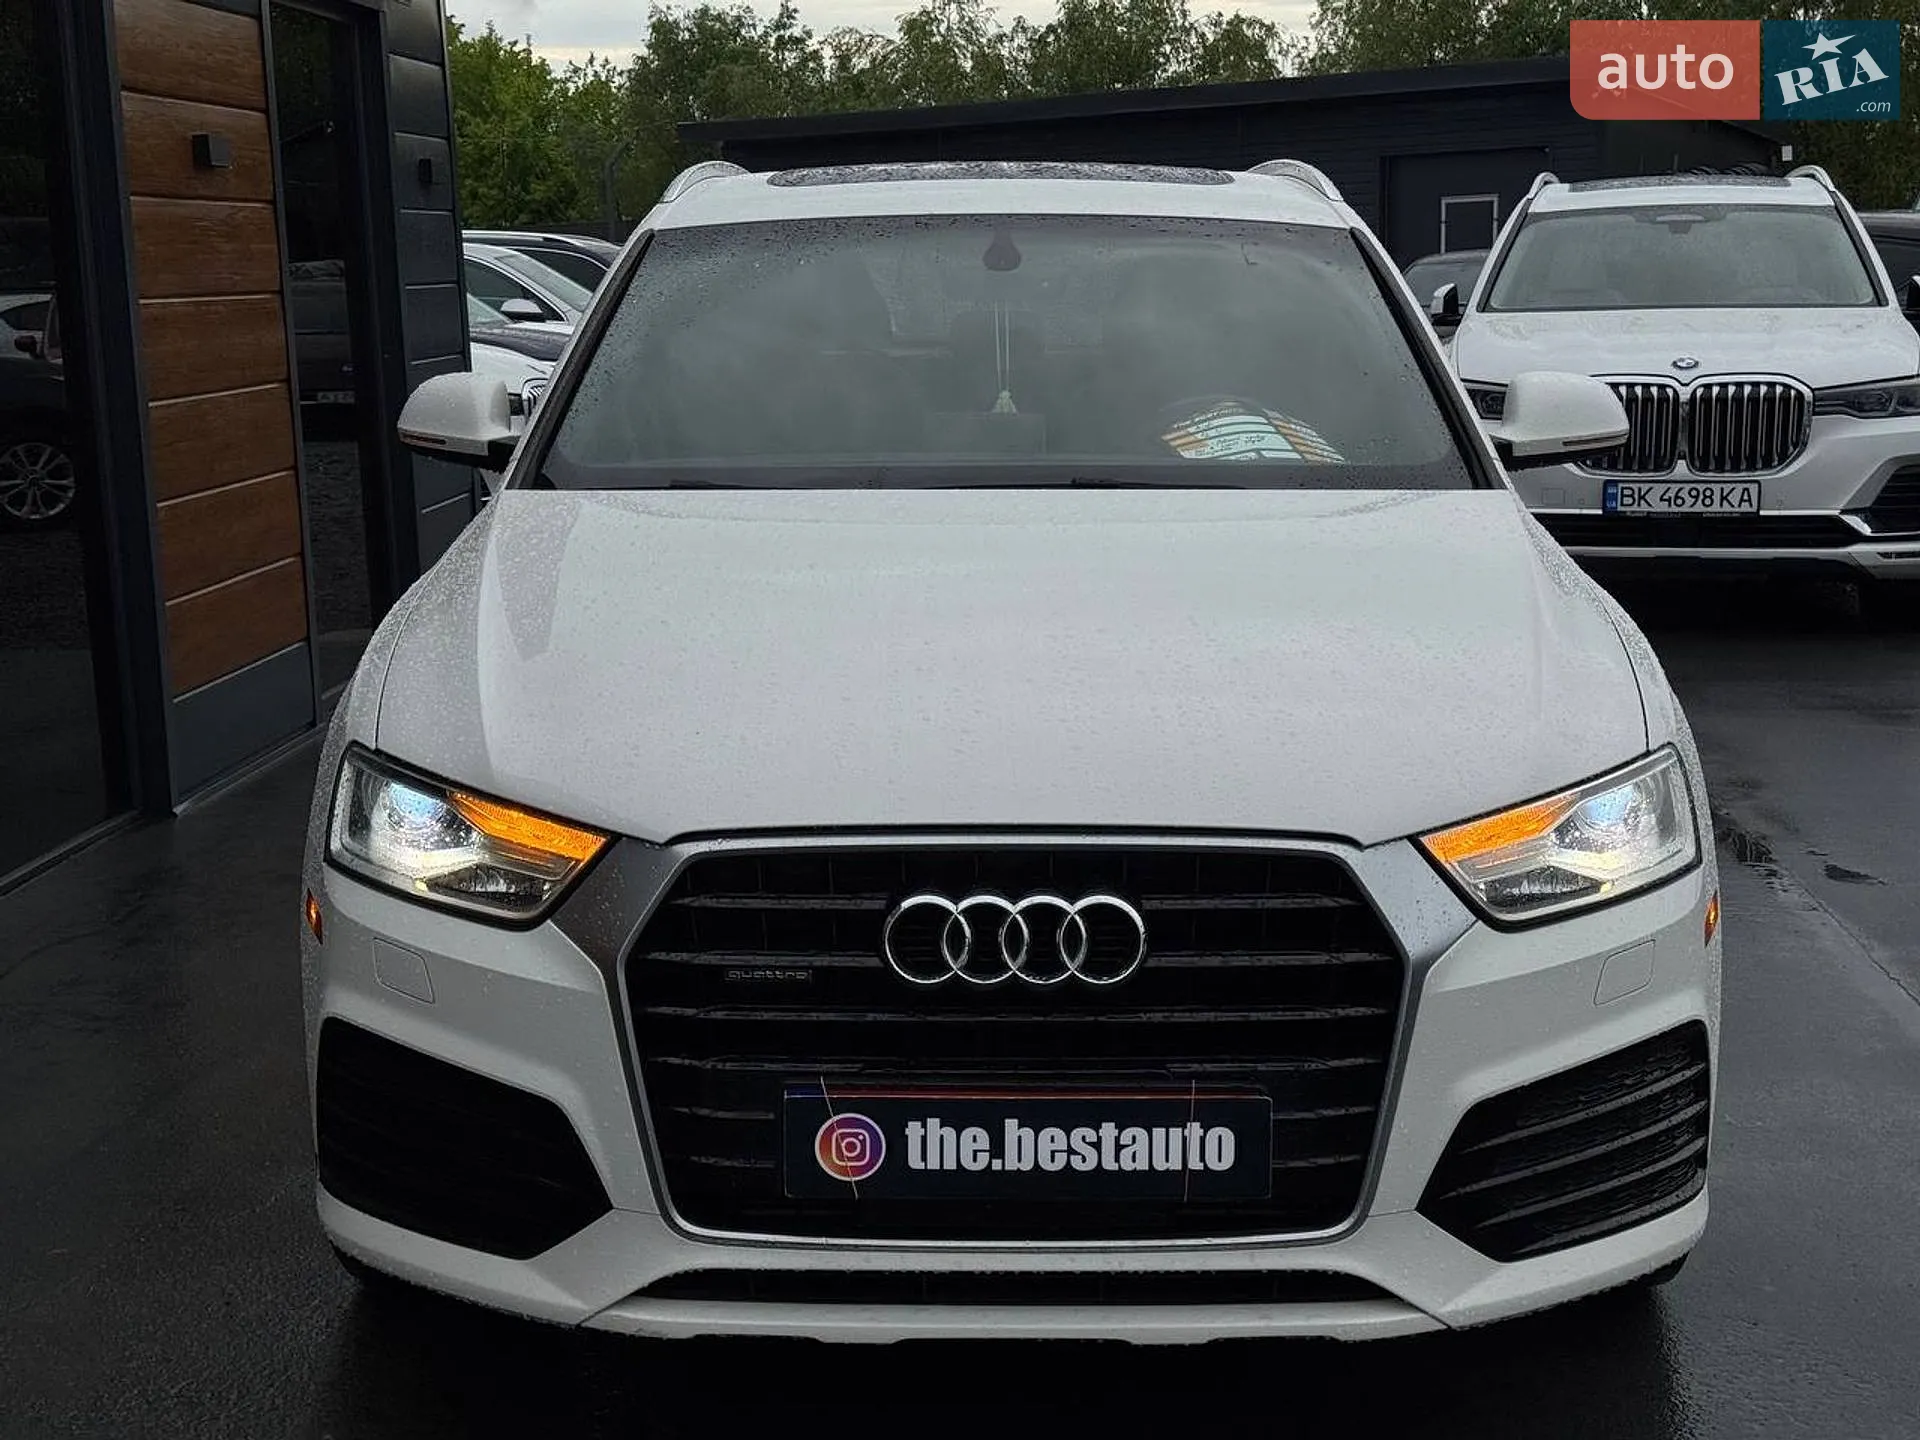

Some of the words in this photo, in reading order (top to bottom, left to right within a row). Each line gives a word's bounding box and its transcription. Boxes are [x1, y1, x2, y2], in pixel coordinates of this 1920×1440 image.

[1620, 486, 1653, 508] BK
[1659, 486, 1714, 508] 4698
[1719, 486, 1753, 508] KA
[727, 970, 809, 981] quattro
[905, 1117, 1236, 1172] the.bestauto
